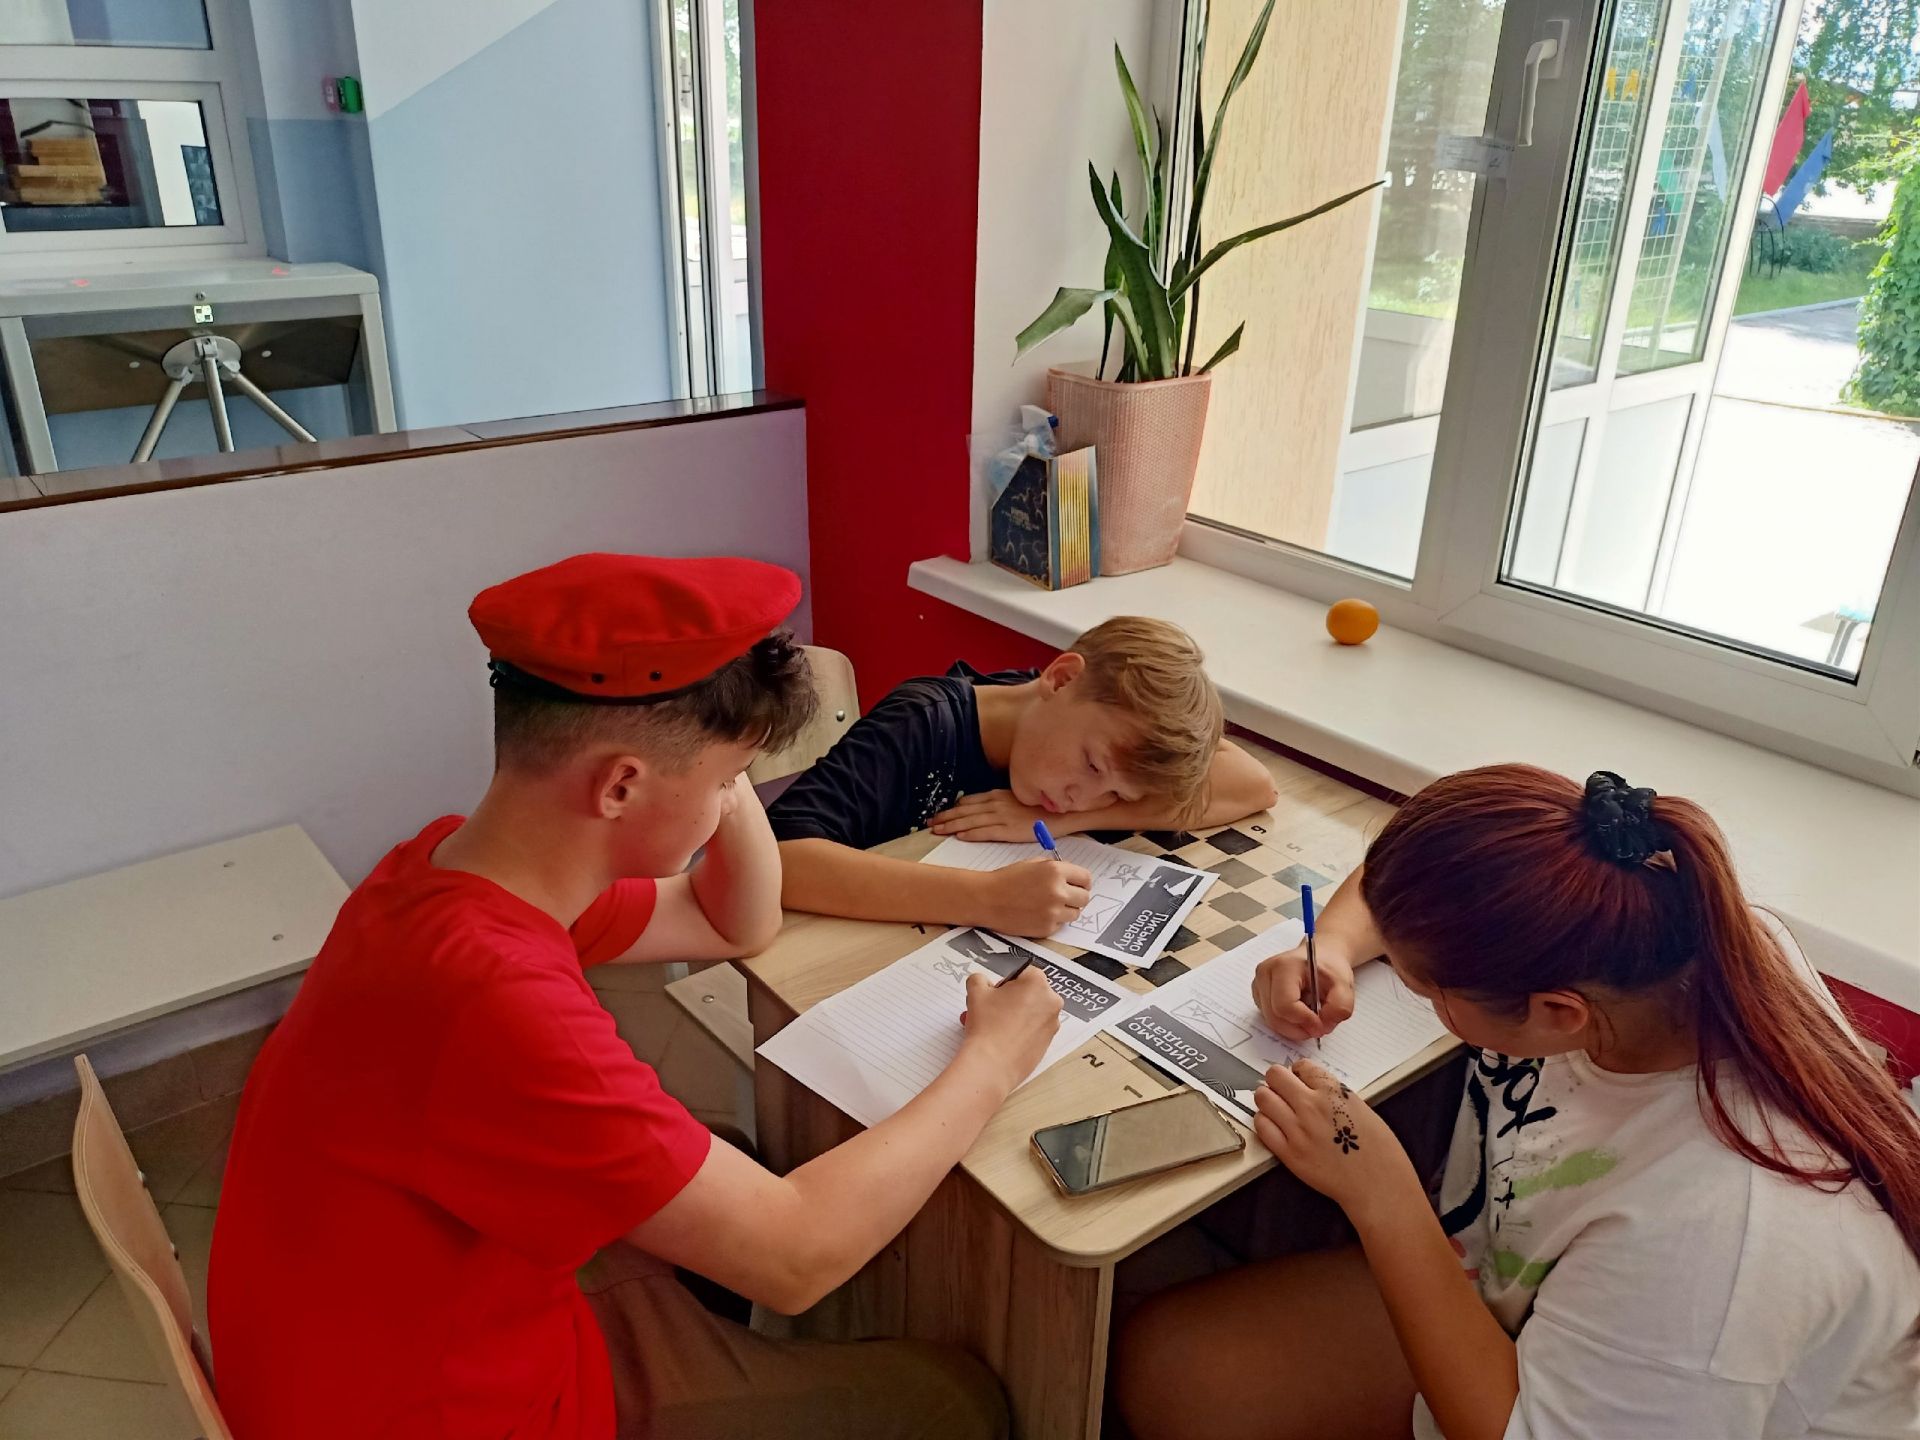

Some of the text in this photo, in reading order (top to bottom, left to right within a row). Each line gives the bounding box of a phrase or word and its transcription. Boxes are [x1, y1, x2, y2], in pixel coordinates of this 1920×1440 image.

[1113, 909, 1153, 950] солдату
[1129, 912, 1169, 952] Письмо
[1042, 964, 1109, 1004] Письмо
[1128, 1022, 1198, 1070] Письмо
[1135, 1016, 1208, 1063] солдату
[1082, 1053, 1105, 1068] 2
